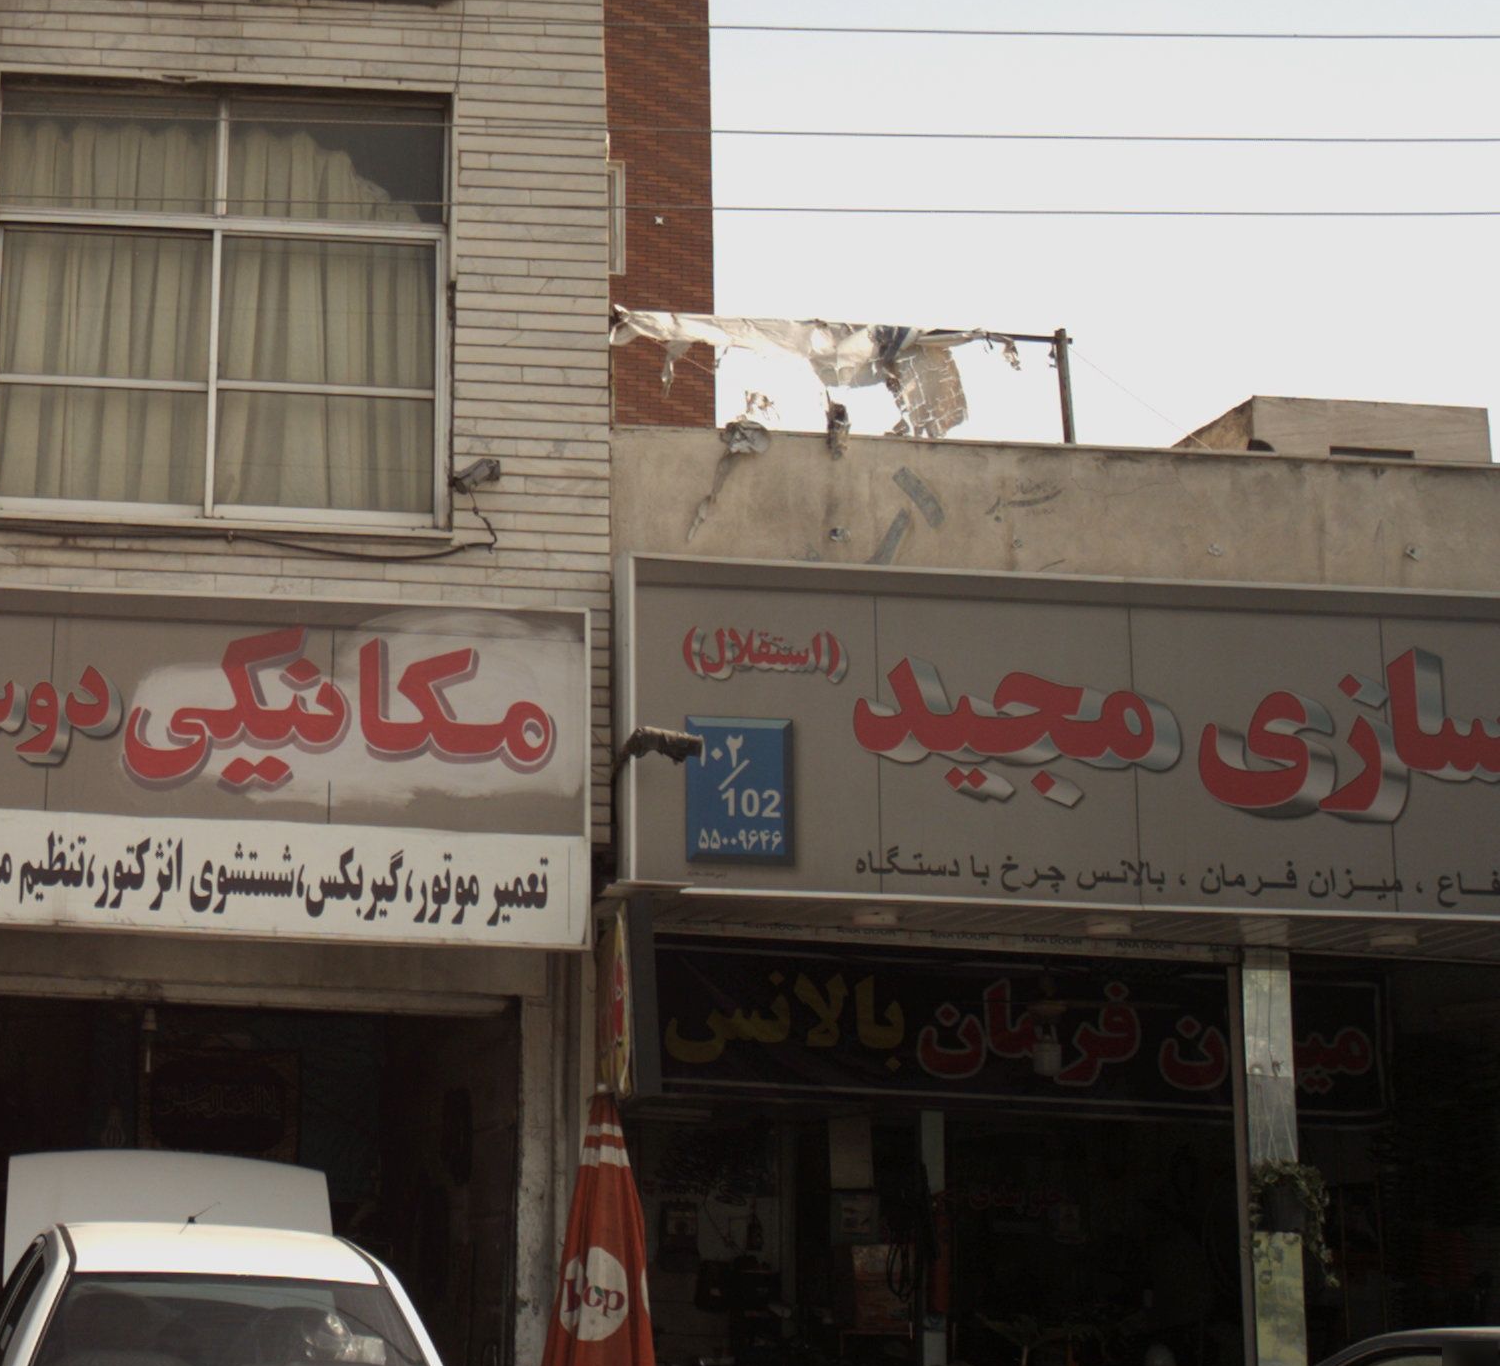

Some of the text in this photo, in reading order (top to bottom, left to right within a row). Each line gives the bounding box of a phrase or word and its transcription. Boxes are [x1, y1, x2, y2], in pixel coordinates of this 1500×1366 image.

[680, 623, 848, 685] (استقلال)
[122, 627, 558, 792] مکانیکی
[851, 654, 1183, 809] مجید
[720, 787, 782, 819] 102
[189, 841, 295, 914] شستشوی
[855, 844, 961, 877] دستگاه
[970, 854, 990, 885] با
[999, 854, 1066, 893] چرخ
[1075, 858, 1166, 893] بالانس
[1199, 860, 1298, 897] فرمان
[1307, 866, 1403, 900] میزان
[486, 855, 549, 926] تعمیر
[663, 969, 905, 1073] بالانس
[1157, 1015, 1374, 1095] مین
